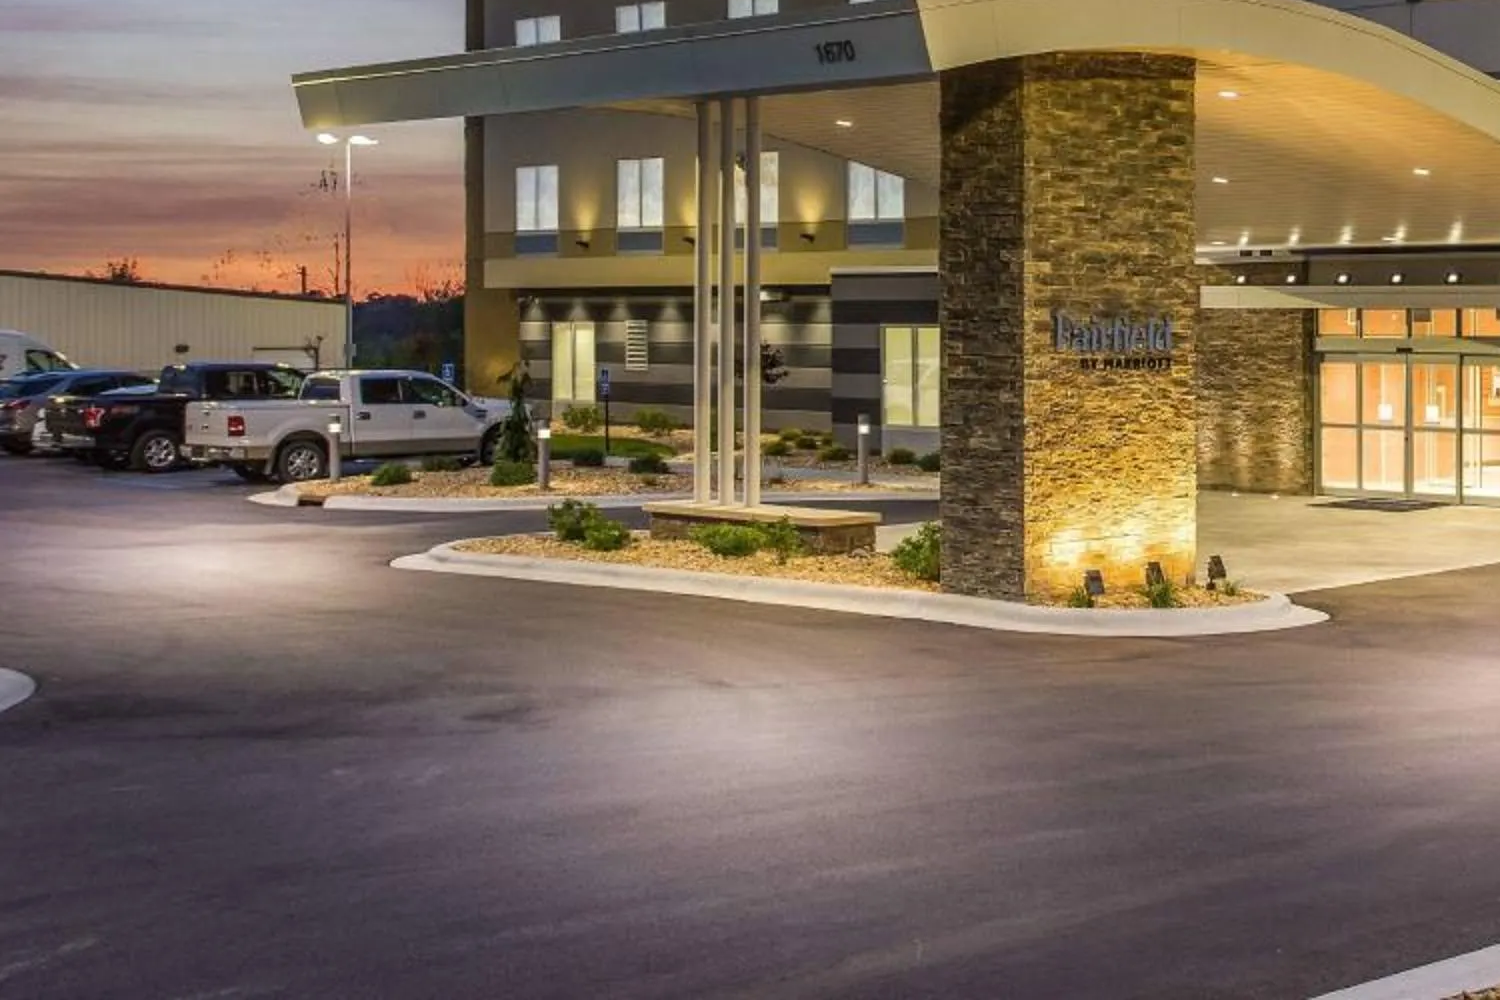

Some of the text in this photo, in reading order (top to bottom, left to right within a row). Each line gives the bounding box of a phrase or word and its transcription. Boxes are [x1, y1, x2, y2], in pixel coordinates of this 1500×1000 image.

[815, 39, 857, 66] 1670
[1054, 309, 1173, 354] Fairfield
[1080, 356, 1171, 370] BY MARRIOTT
